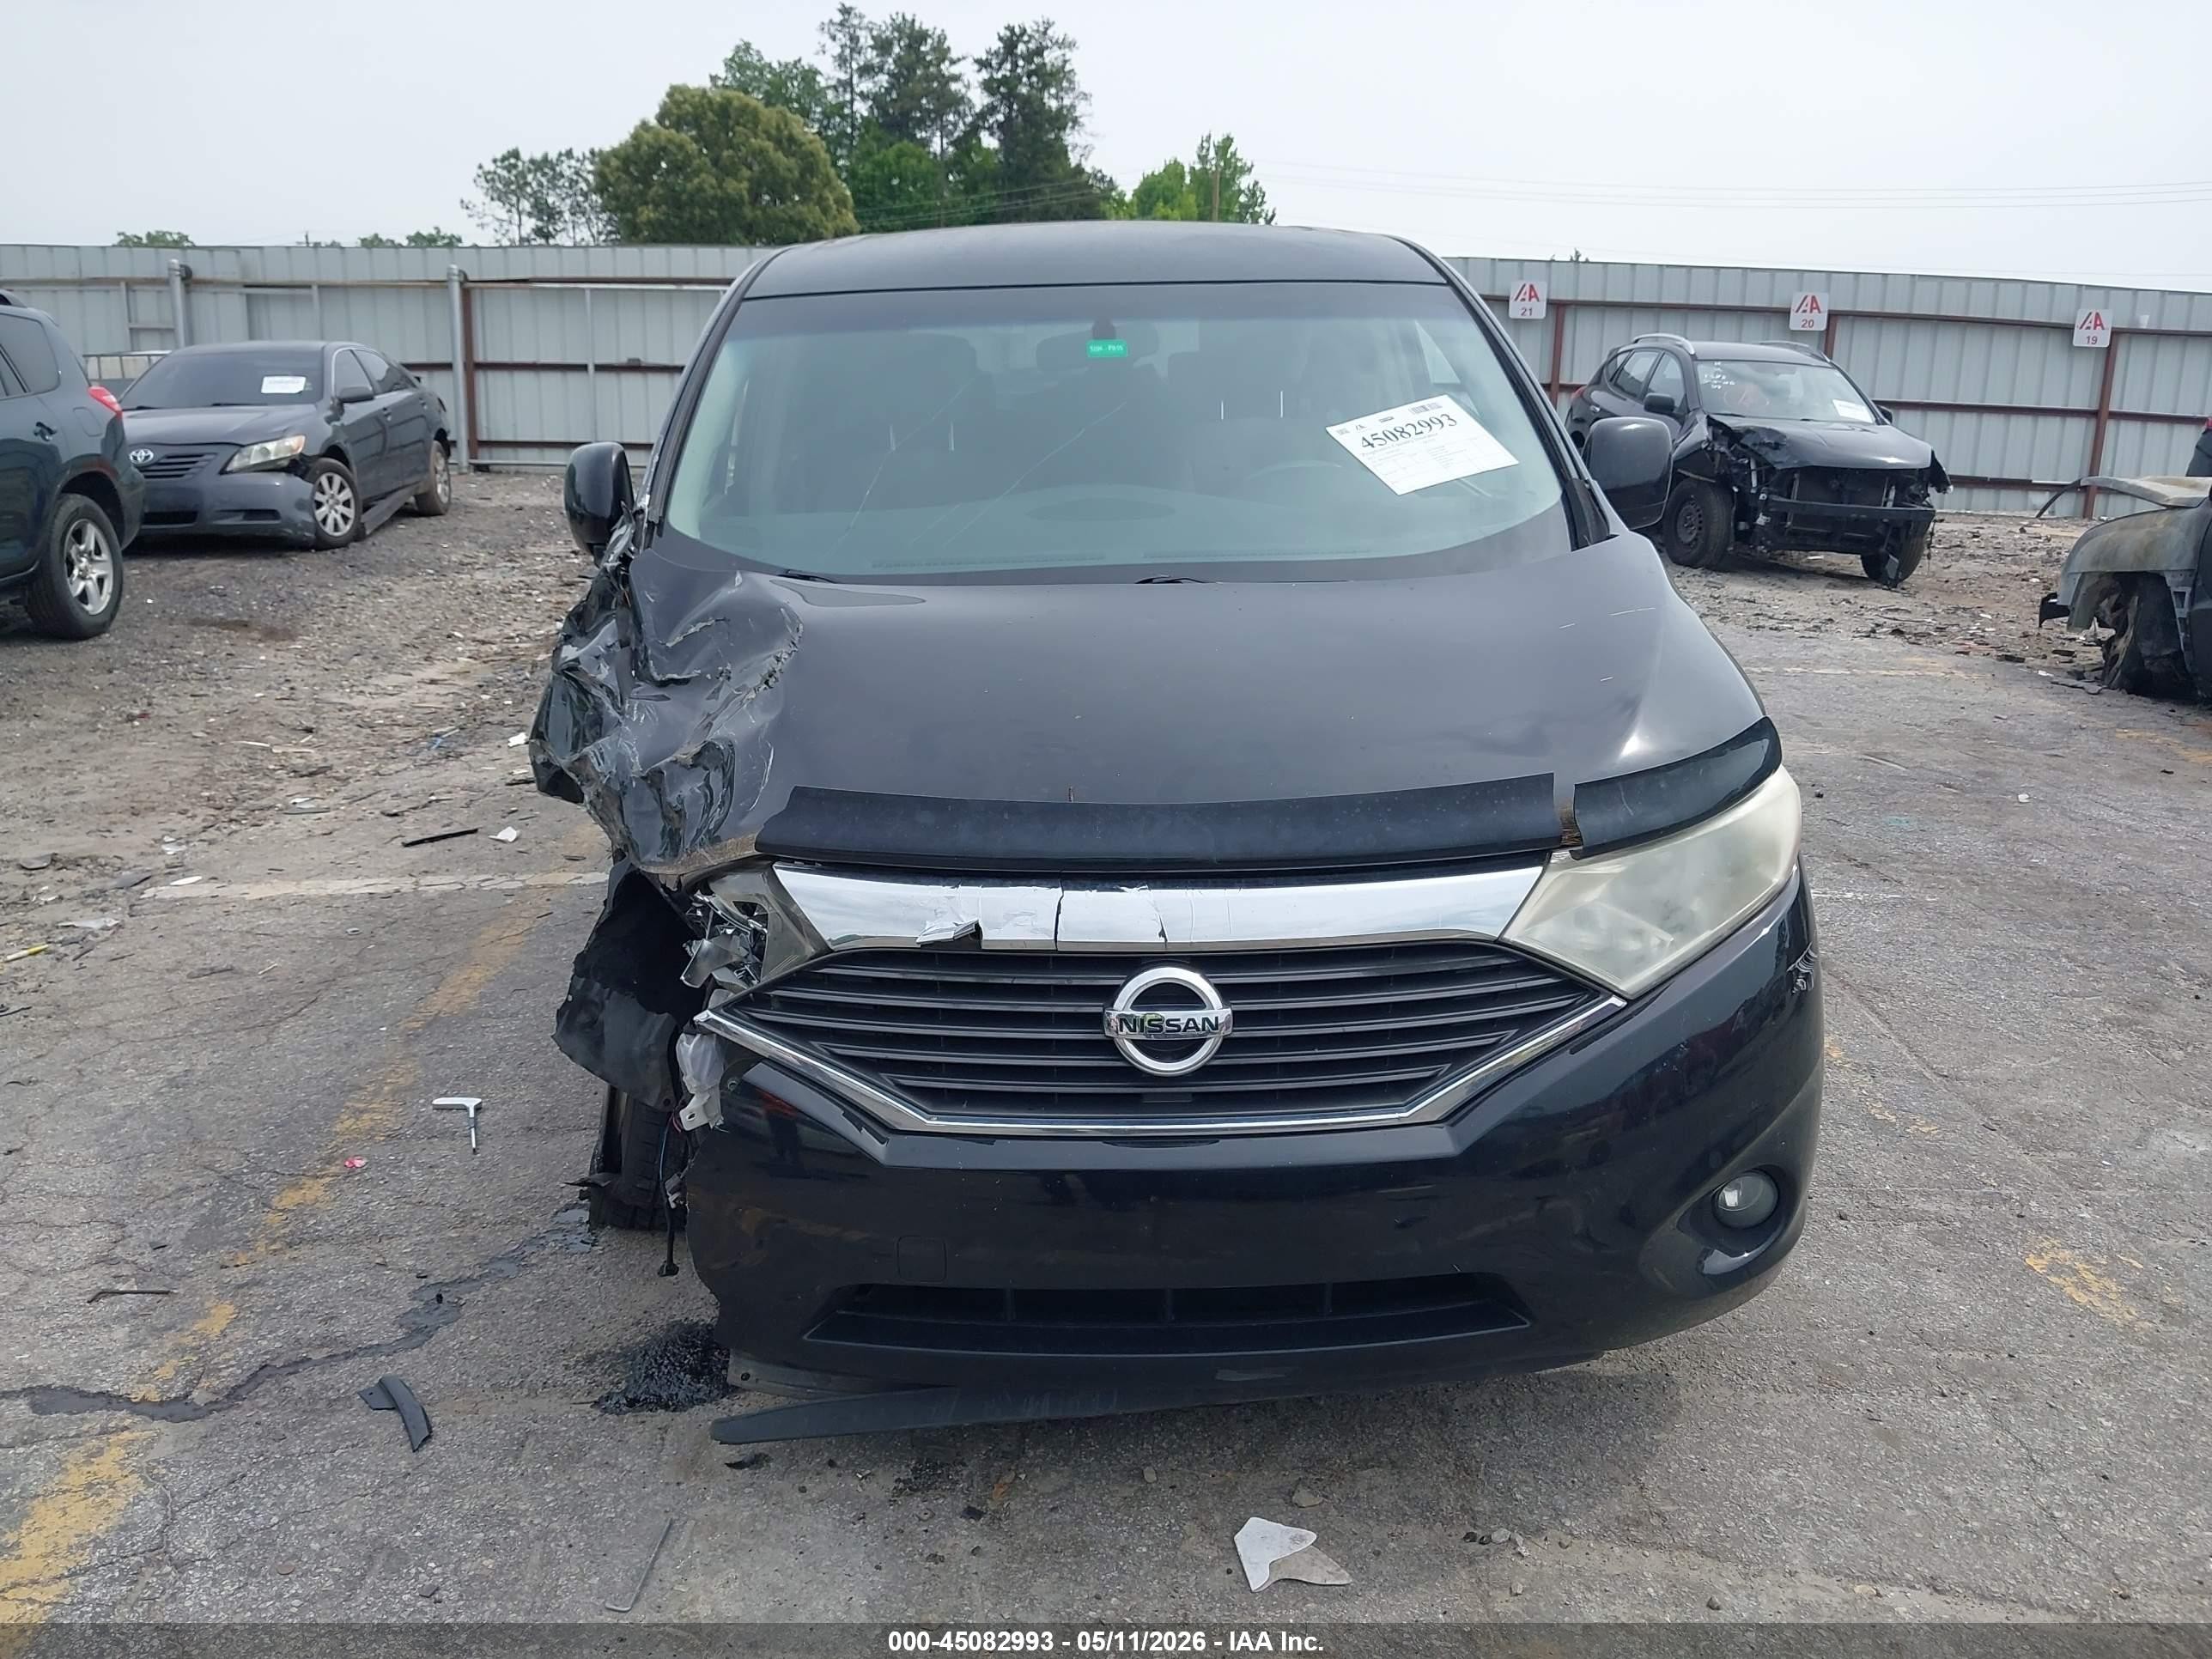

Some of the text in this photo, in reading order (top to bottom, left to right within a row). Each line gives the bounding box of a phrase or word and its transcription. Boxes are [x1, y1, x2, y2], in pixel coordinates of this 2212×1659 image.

[1520, 307, 1533, 317] 21
[1801, 319, 1814, 328] 20
[2086, 335, 2098, 345] 19
[1360, 413, 1458, 450] 45082993
[1119, 1016, 1219, 1033] NISSAN
